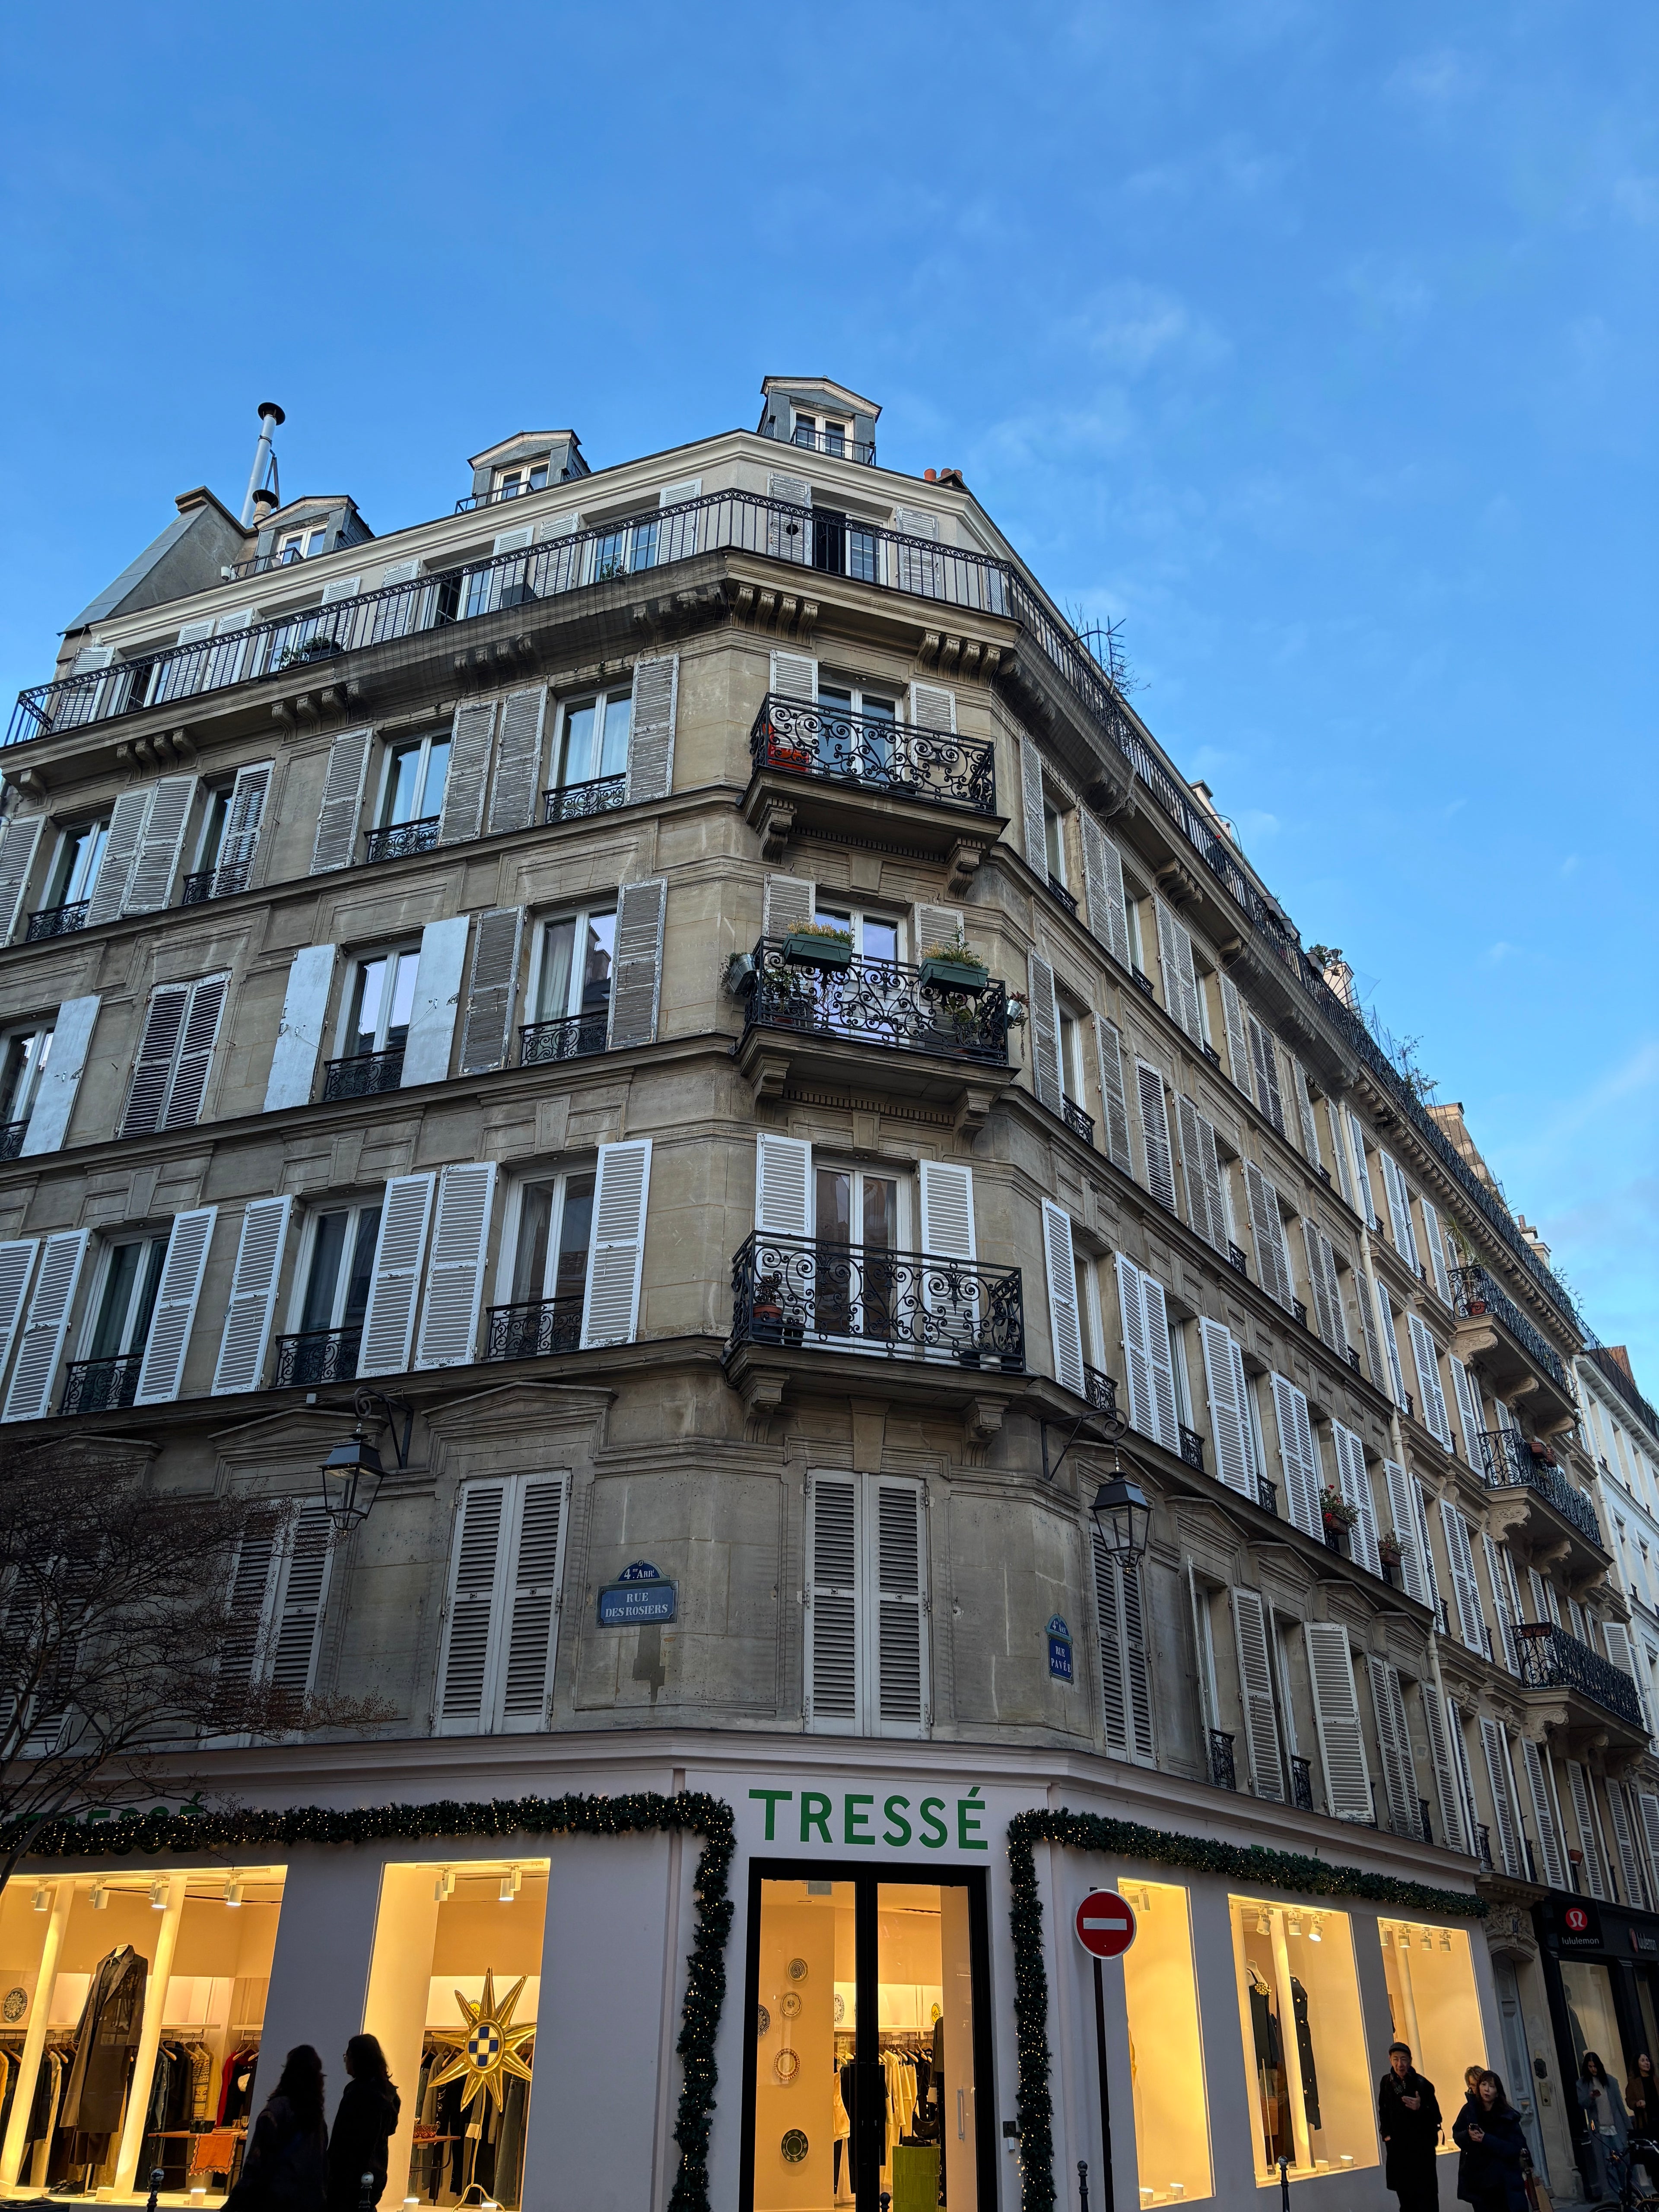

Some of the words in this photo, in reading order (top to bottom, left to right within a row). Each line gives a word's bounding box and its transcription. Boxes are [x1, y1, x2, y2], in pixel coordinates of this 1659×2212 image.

[626, 1592, 648, 1602] RUE
[605, 1607, 624, 1618] DES
[626, 1604, 668, 1616] ROSIERS
[1055, 1646, 1065, 1657] RUE
[1051, 1658, 1071, 1673] PAVÉE
[749, 1786, 988, 1850] TRESSÉ
